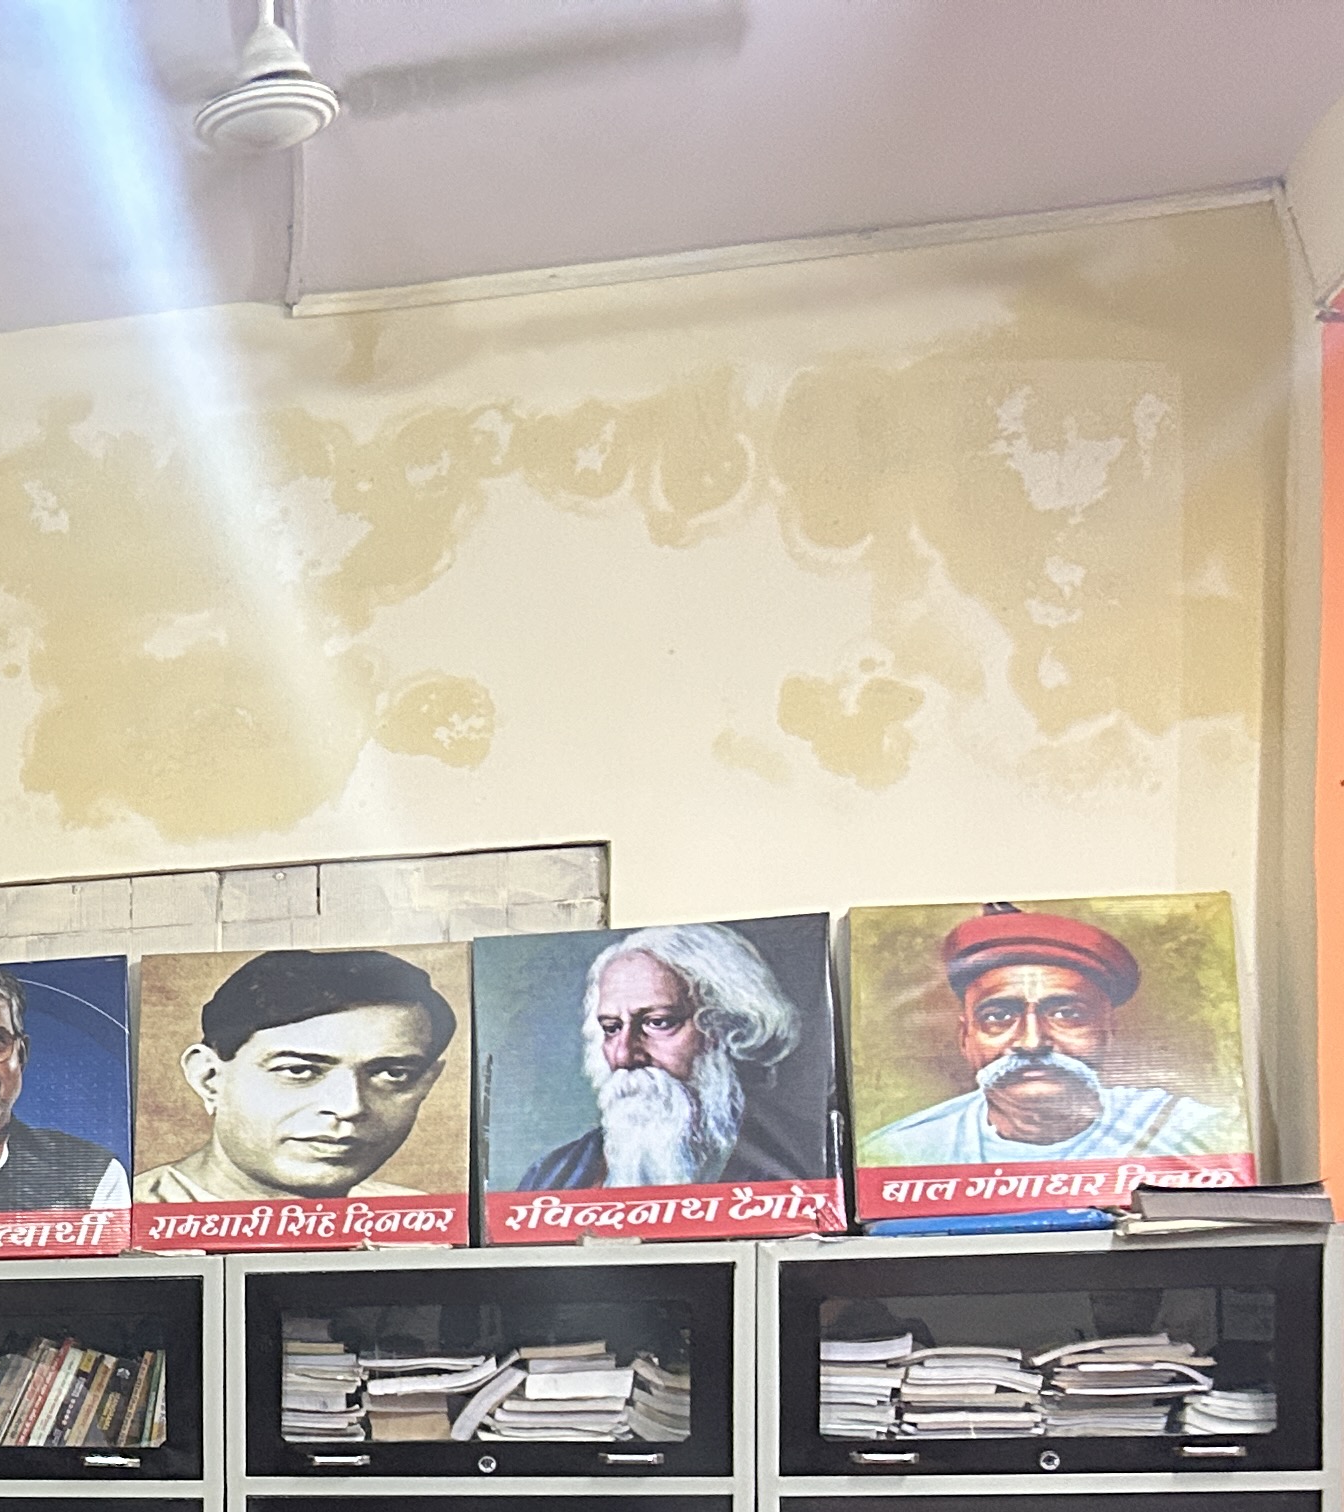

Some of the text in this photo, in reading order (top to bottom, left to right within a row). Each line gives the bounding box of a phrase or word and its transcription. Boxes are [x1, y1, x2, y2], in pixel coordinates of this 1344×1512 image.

[882, 1177, 960, 1203] बाल
[964, 1168, 1109, 1199] गंगाधर
[148, 1202, 456, 1240] रामधारी सिंह दिनकर
[505, 1185, 831, 1231] रविन्द्रनाथ टैगोर
